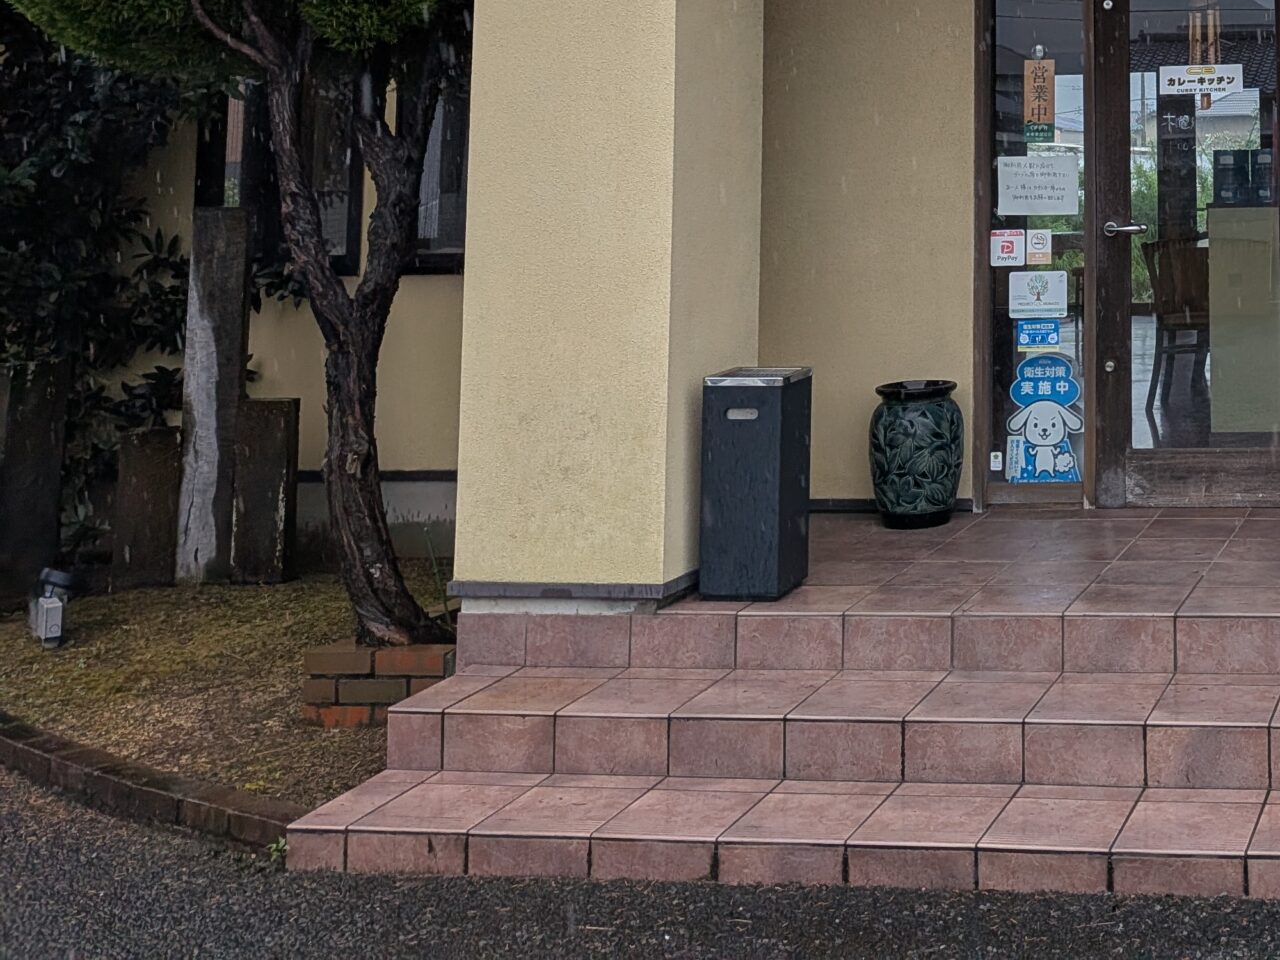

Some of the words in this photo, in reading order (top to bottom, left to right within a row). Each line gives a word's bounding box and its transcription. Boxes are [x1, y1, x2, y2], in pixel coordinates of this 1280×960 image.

[1167, 76, 1235, 86] カレーキッチン
[1031, 65, 1048, 121] 営業中
[1024, 366, 1066, 378] 衛生対策
[1020, 380, 1069, 395] 実施中
